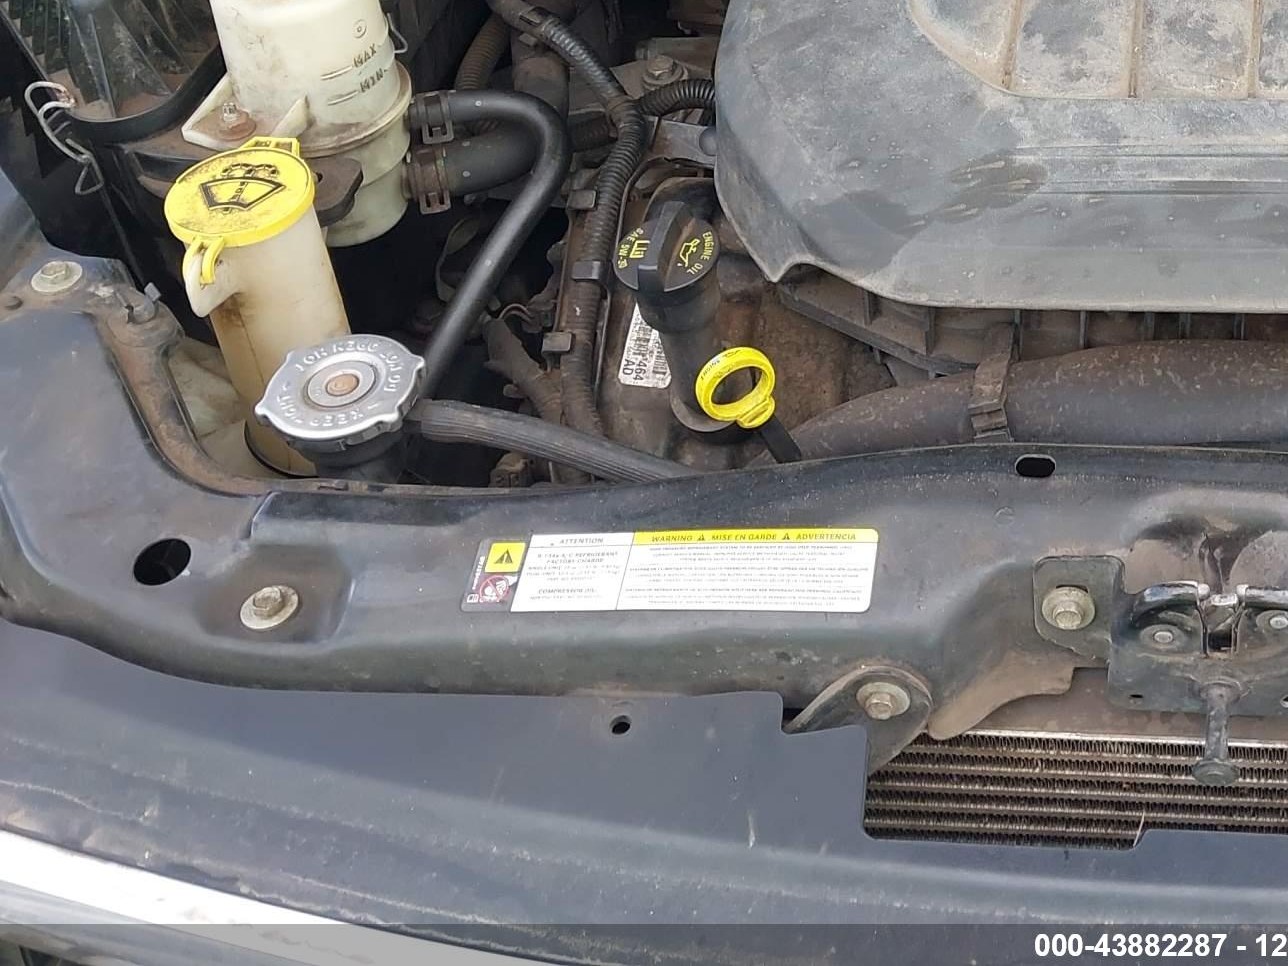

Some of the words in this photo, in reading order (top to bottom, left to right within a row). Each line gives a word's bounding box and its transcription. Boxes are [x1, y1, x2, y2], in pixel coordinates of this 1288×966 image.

[353, 43, 377, 68] MAX
[360, 68, 384, 93] MIN
[627, 228, 644, 242] SAE
[701, 231, 715, 261] ENGINE
[687, 263, 704, 275] OIL
[622, 358, 634, 376] AD
[632, 361, 648, 381] 464
[651, 534, 693, 542] WARNING
[711, 533, 732, 541] MISE
[734, 533, 746, 541] EN
[795, 532, 856, 540] ADVERTENCIA
